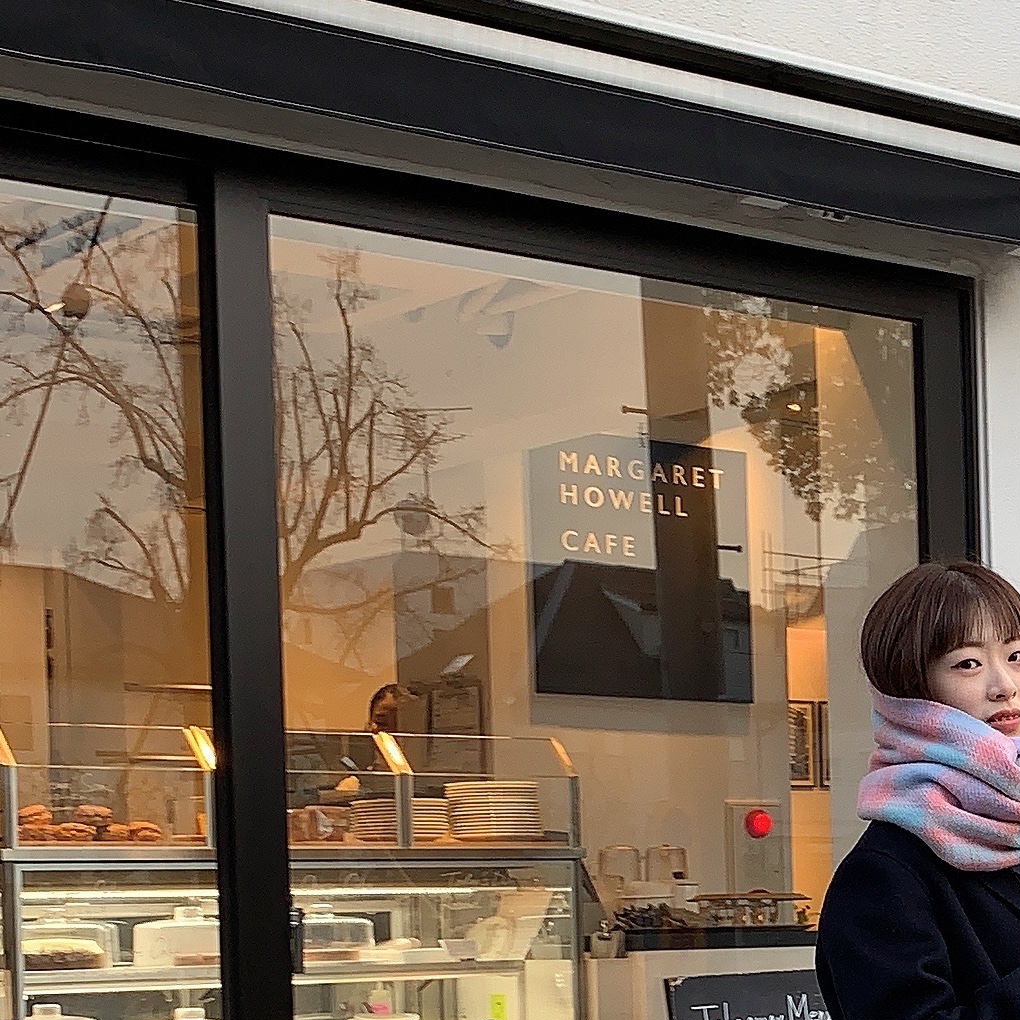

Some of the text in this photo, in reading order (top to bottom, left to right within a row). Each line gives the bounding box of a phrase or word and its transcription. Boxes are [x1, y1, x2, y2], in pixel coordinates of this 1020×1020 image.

[558, 450, 725, 490] MARGARET
[560, 483, 689, 517] HOWELL
[560, 530, 636, 557] CAFE
